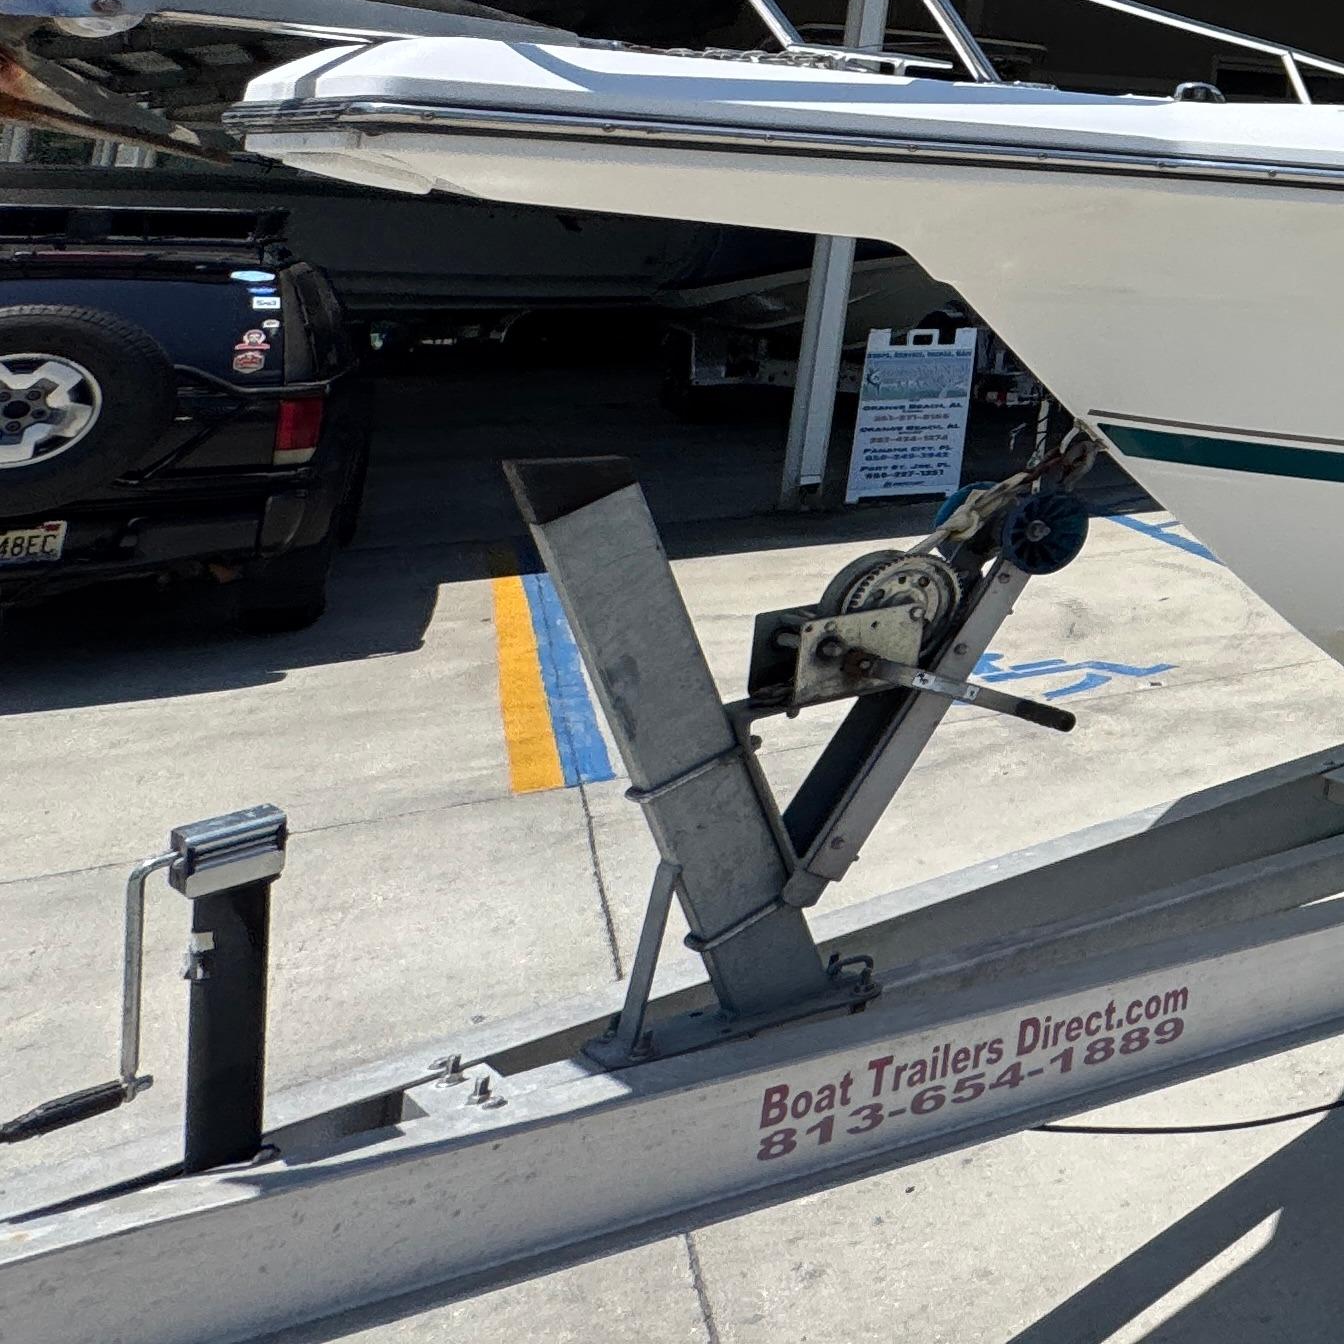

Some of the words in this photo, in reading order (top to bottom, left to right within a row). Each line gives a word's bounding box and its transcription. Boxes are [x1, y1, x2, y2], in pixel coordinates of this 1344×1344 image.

[756, 1016, 1185, 1162] 813-654-1889
[759, 1070, 854, 1130] Boat
[867, 1036, 1004, 1098] Trailers
[1015, 985, 1189, 1057] Direct.com
